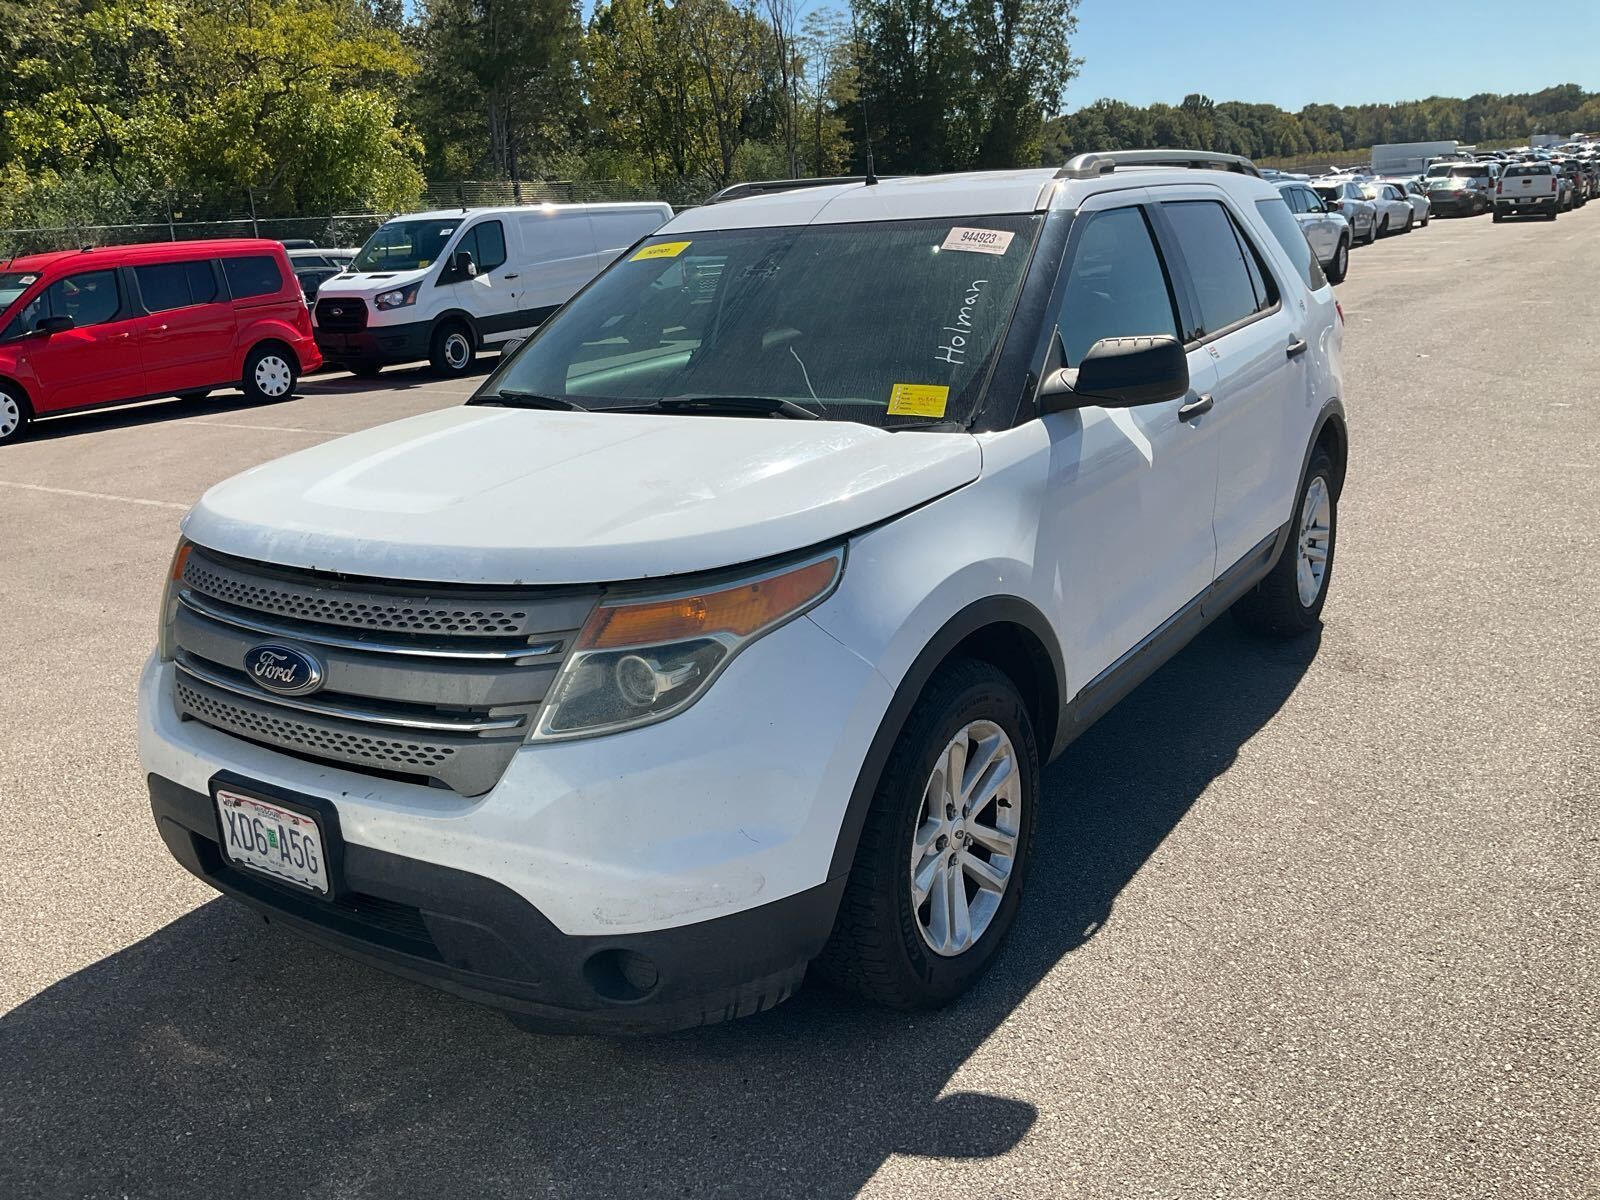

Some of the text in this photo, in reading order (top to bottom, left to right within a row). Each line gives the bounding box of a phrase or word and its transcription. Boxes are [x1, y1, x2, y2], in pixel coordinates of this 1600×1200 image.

[960, 231, 997, 244] 944923
[934, 280, 989, 365] Holman
[254, 651, 297, 683] Ford
[224, 809, 318, 875] XD6 A5G
